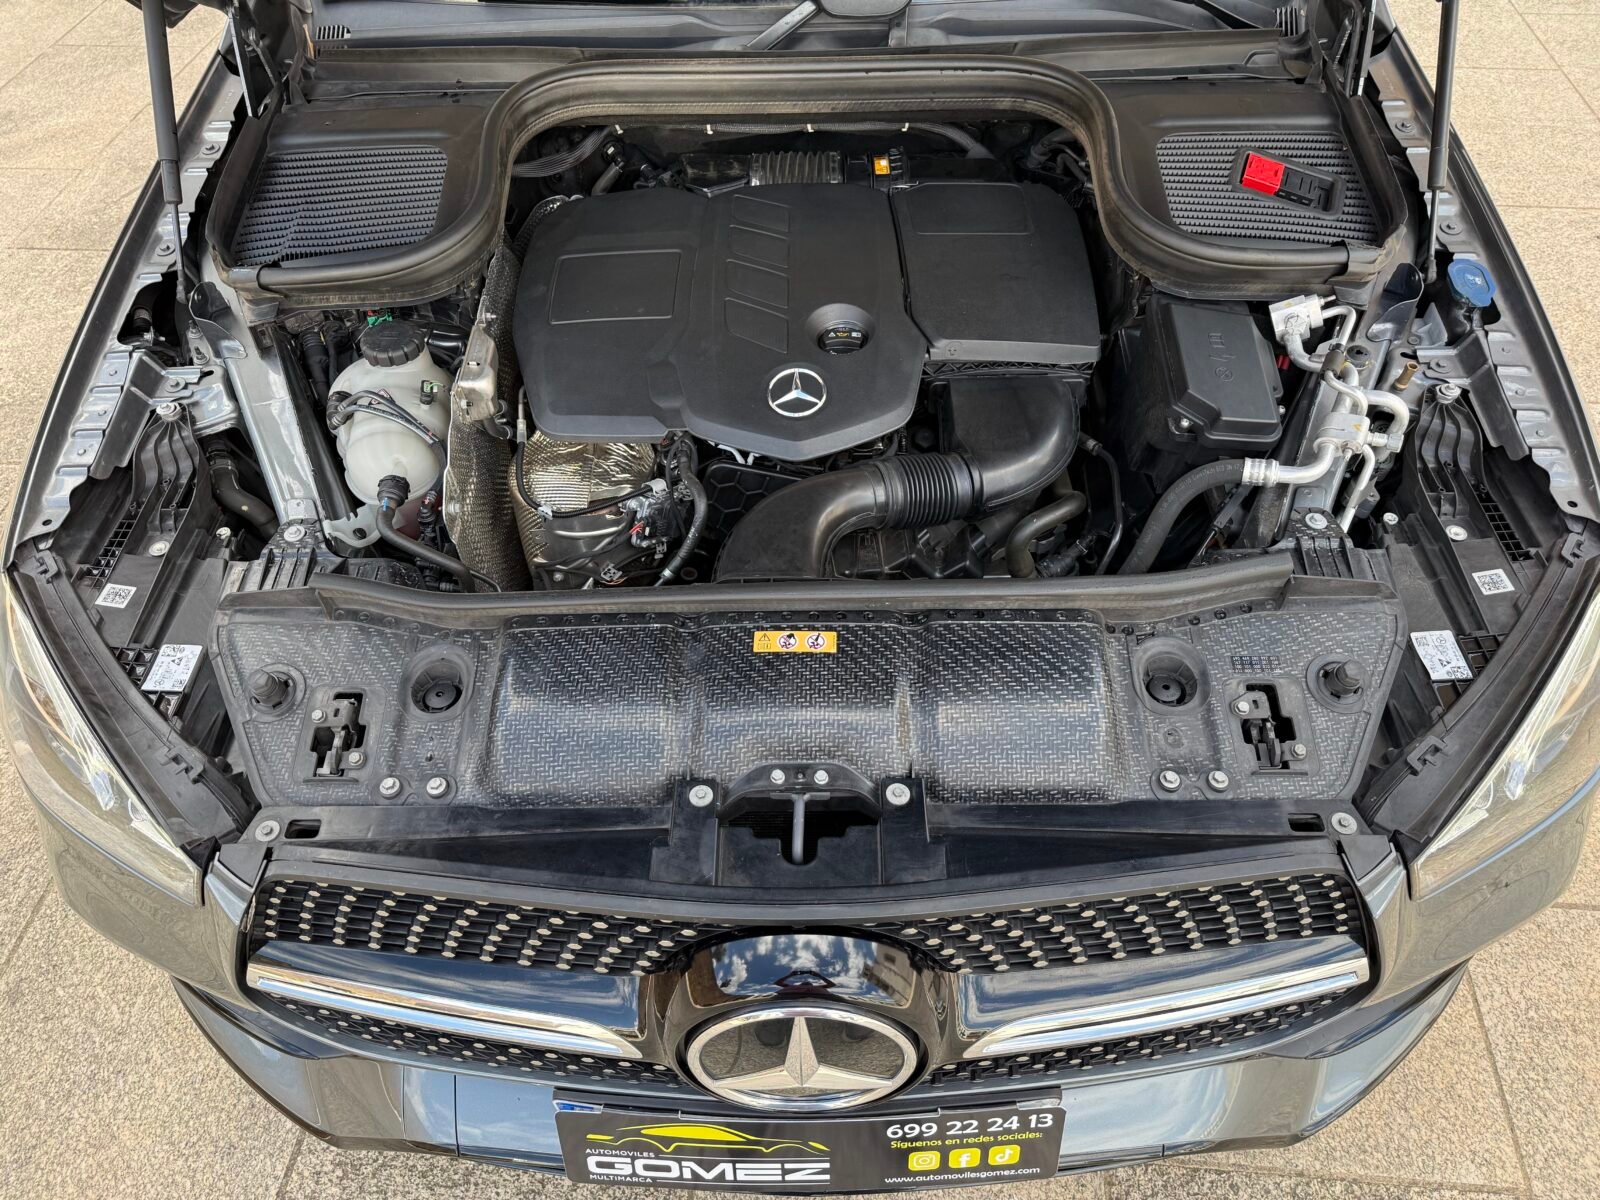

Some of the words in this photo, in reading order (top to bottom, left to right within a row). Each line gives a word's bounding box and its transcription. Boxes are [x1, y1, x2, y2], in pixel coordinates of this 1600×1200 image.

[886, 1122, 938, 1139] 699
[945, 1119, 979, 1135] 22
[987, 1115, 1020, 1132] 24
[1028, 1113, 1054, 1129] 13
[945, 1138, 960, 1146] en
[963, 1135, 994, 1144] redes
[997, 1131, 1043, 1142] sociales:
[585, 1148, 655, 1158] AUTOMOVILES
[586, 1156, 830, 1181] GOMEZ
[884, 1166, 1041, 1184] www.automovilesgomez.com
[589, 1174, 653, 1183] MULTIMARCA
